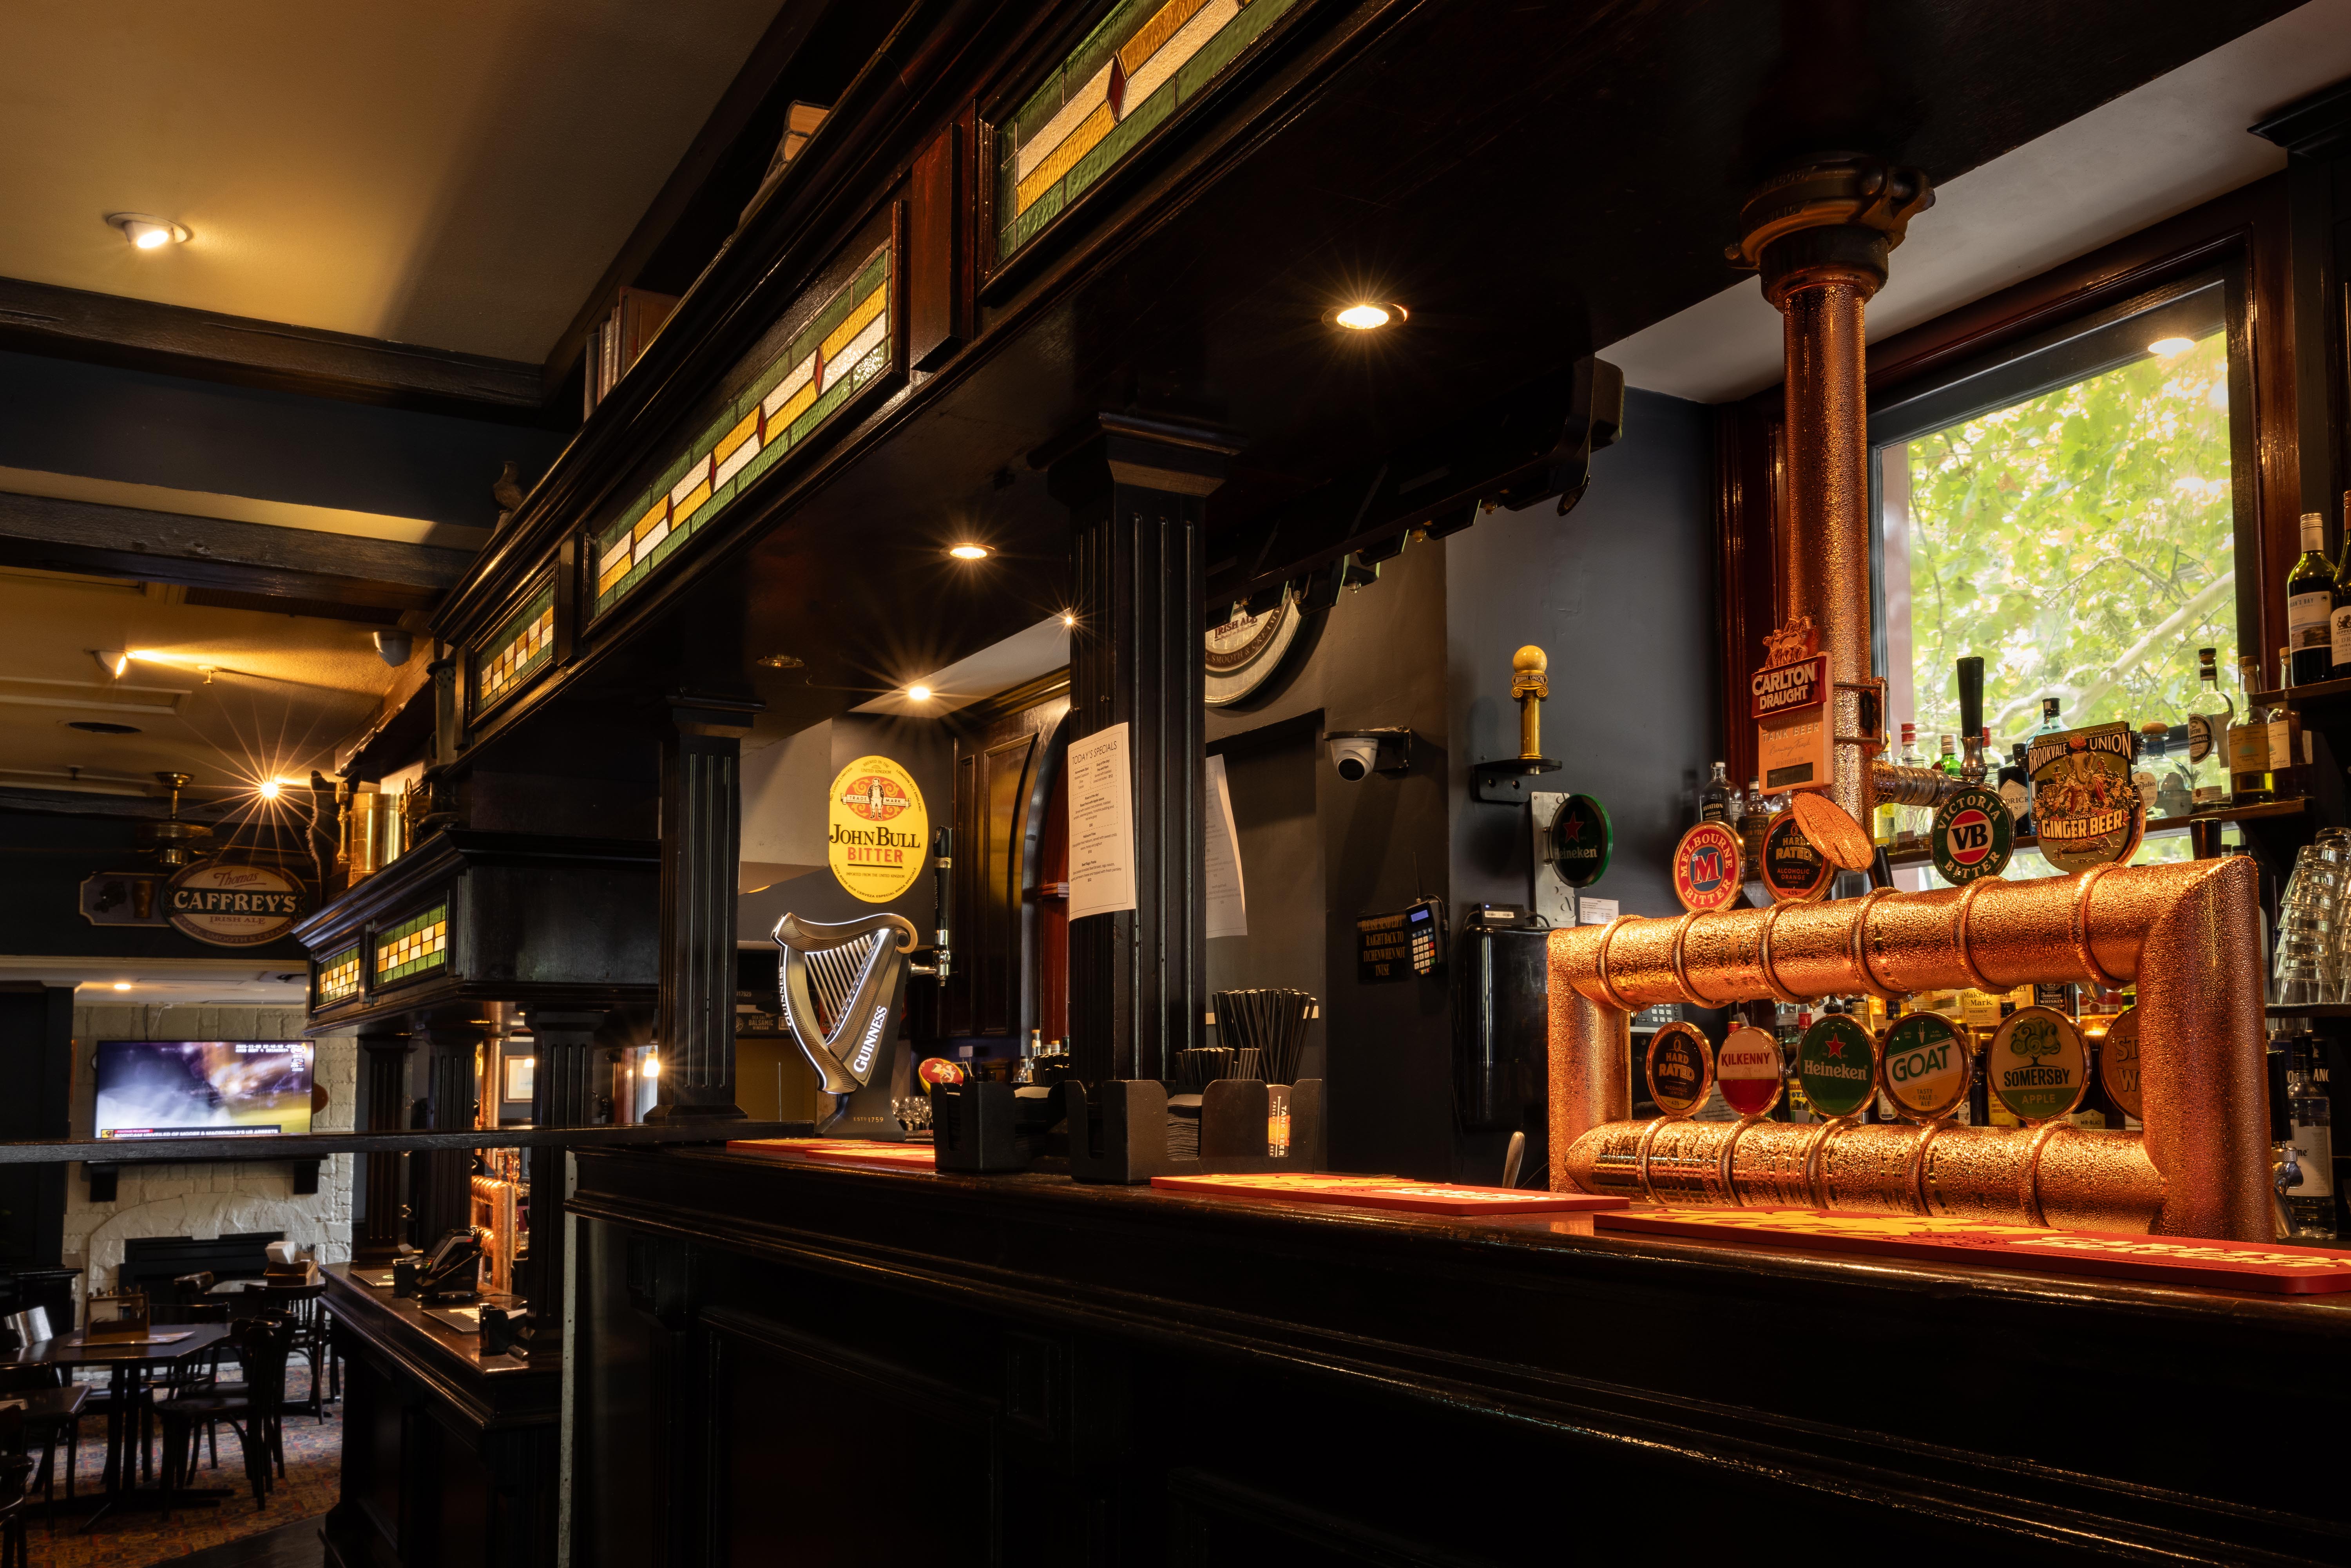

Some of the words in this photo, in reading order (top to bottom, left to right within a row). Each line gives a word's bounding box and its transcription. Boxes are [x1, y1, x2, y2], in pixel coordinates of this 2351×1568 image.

[1215, 620, 1238, 638] IRISH
[1212, 650, 1243, 663] SMOOTH
[1752, 662, 1818, 695] CARLTON
[1759, 685, 1808, 710] DRAUGHT
[1762, 728, 1789, 743] TANK
[1793, 722, 1819, 736] BEER
[1072, 750, 1093, 765] TODAY'S
[1094, 741, 1117, 757] SPECIALS
[2028, 742, 2067, 775] BROOKVALE
[2089, 732, 2132, 760] UNION
[840, 767, 853, 781] LIMITED
[896, 769, 910, 784] LONDON
[2139, 781, 2155, 791] Julio
[1703, 802, 1723, 811] AVIATION
[1938, 795, 2000, 829] VICTORIA
[2041, 818, 2087, 839] GINGER
[2090, 809, 2123, 837] BEER
[2066, 811, 2097, 821] ALCOHOLIC
[829, 824, 875, 846] JOHN
[875, 826, 920, 848] BULL
[1782, 837, 1806, 846] HARD
[1951, 823, 1989, 851] VB
[847, 847, 903, 863] BITTER
[1554, 846, 1598, 860] Heineken
[1681, 833, 1733, 878] MELBOURNE
[1775, 847, 1811, 861] RATED
[1693, 852, 1721, 885] M
[1944, 851, 2000, 878] BITTER
[214, 870, 259, 887] Thomas
[895, 884, 906, 893] BIRRA
[905, 867, 916, 884] SPECIALE
[1684, 878, 1732, 905] BITTER
[174, 891, 297, 913] CAFFREY'S
[1362, 919, 1378, 932] PLEASE
[1379, 917, 1391, 929] SEND
[206, 932, 248, 943] SMOOTH
[1384, 932, 1396, 944] BACK
[1397, 931, 1404, 943] TO
[1380, 947, 1395, 960] WHEN
[1396, 946, 1406, 959] NOT
[1375, 964, 1381, 976] IN
[1381, 964, 1390, 976] USE
[778, 966, 792, 1027] GUINNESS
[853, 1005, 887, 1072] GUINNESS
[1666, 1052, 1689, 1064] HARD
[1721, 1052, 1770, 1067] KILKENNY
[1892, 1044, 1950, 1082] GOAT
[1659, 1063, 1695, 1081] RATED
[1803, 1059, 1868, 1081] Heineken
[2003, 1068, 2070, 1087] SOMERSBY
[1665, 1085, 1688, 1093] ALCOHOLIC
[2021, 1094, 2056, 1104] APPLE
[1371, 1189, 1522, 1201] DRAUGHT
[1401, 1188, 1566, 1200] CARLTON
[2007, 1240, 2338, 1268] DRAUGHT
